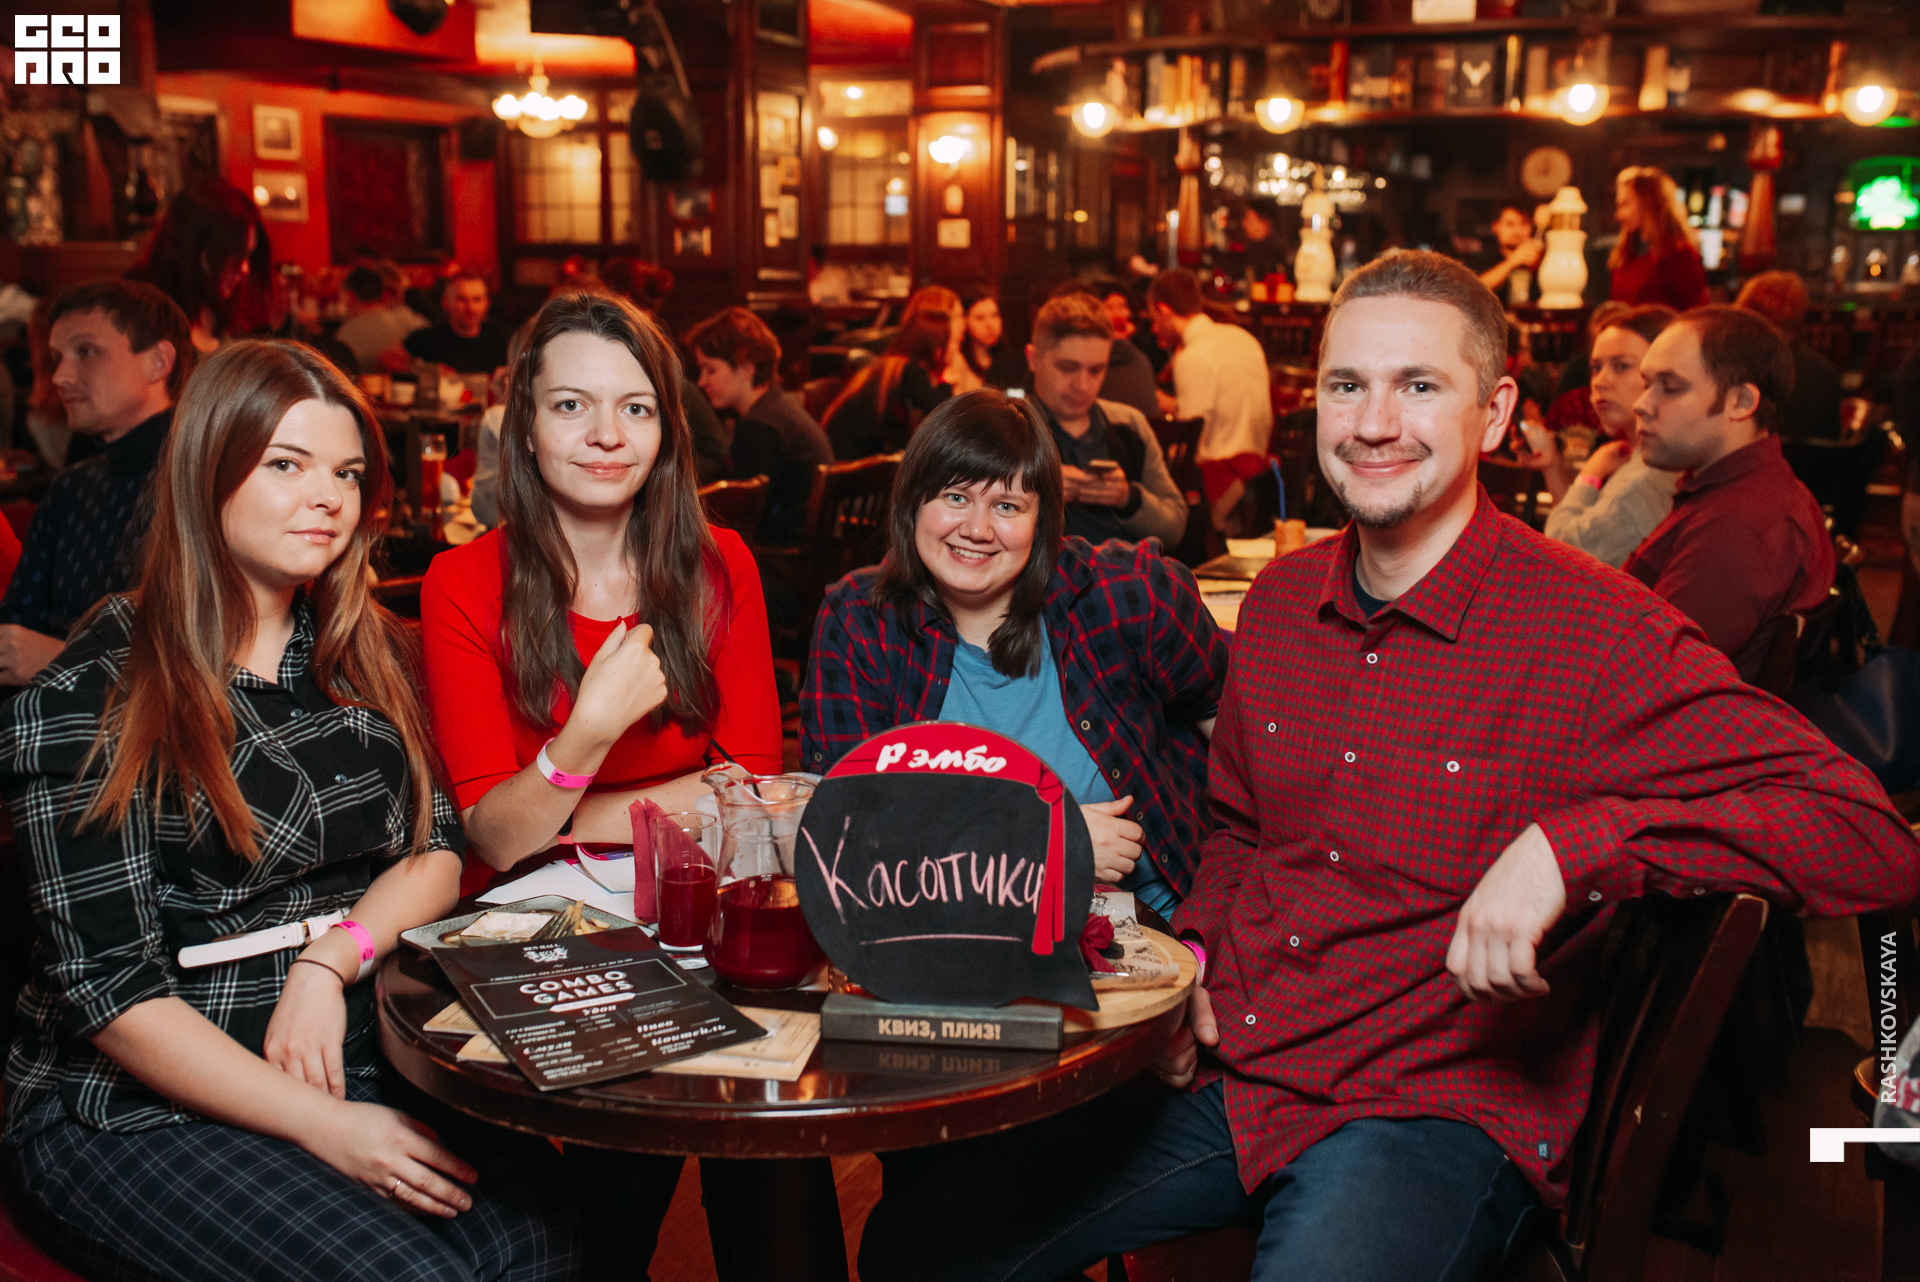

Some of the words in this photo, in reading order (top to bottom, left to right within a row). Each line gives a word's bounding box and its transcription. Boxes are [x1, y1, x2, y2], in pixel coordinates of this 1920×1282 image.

[876, 742, 1007, 773] Рэмбо
[519, 970, 627, 994] COMBO
[533, 980, 634, 1004] GAMES
[878, 1018, 936, 1040] КВИЗ,
[941, 1021, 1001, 1040] ПЛИЗ!
